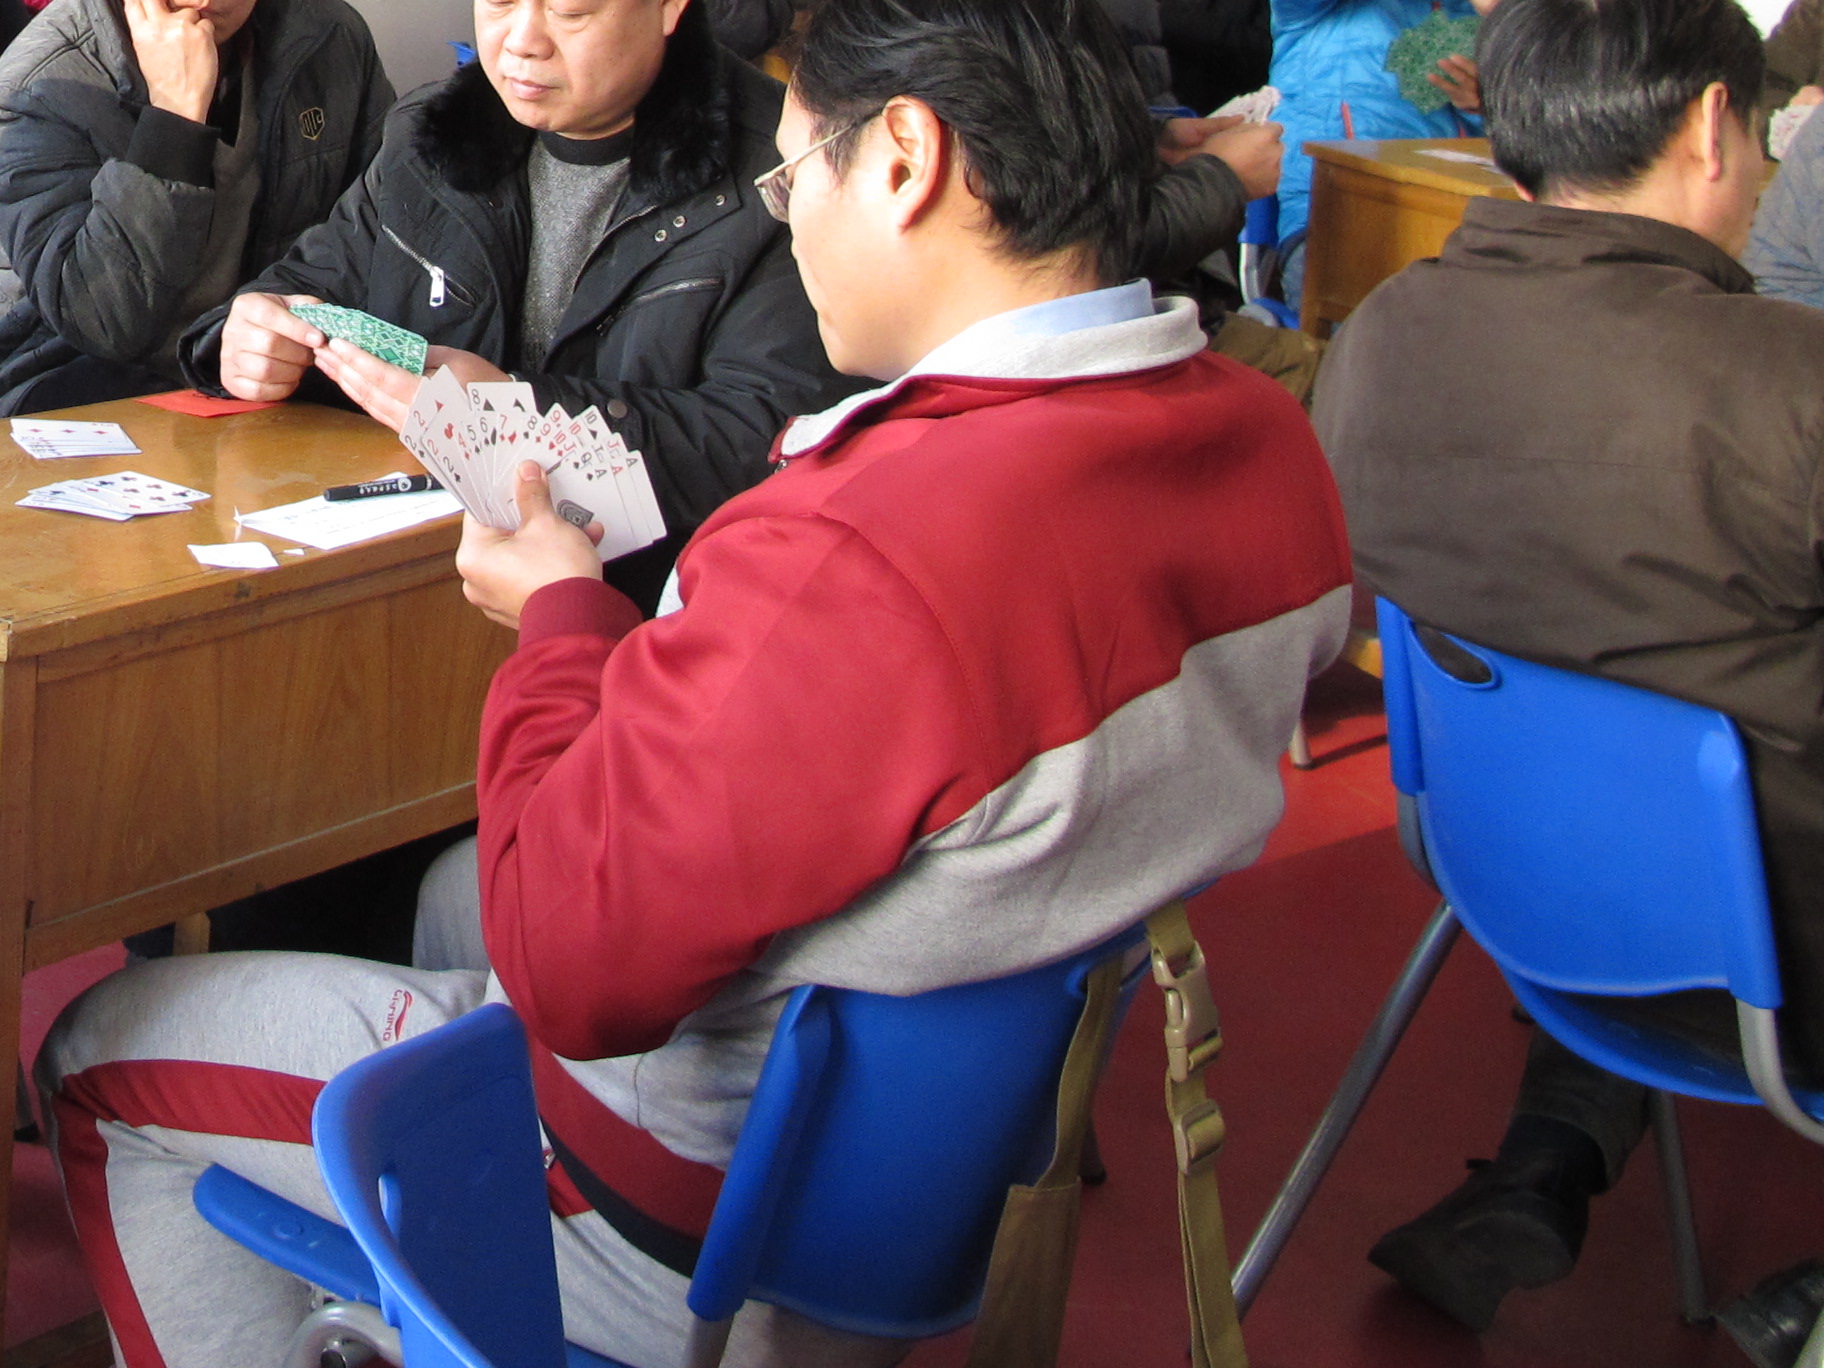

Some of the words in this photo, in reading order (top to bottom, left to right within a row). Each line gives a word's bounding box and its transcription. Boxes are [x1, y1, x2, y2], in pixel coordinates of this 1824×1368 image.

[472, 389, 480, 404] 8
[414, 411, 424, 426] 2
[500, 415, 507, 429] 7
[528, 416, 538, 430] 8
[550, 410, 561, 423] 9
[584, 411, 597, 424] 10
[480, 417, 487, 432] 6
[540, 424, 551, 436] 9
[569, 422, 581, 435] 10
[467, 425, 476, 440] 5
[554, 430, 566, 444] 10
[405, 435, 416, 450] 2
[458, 432, 466, 448] 4
[564, 442, 577, 451] J
[608, 441, 620, 449] J
[427, 440, 438, 455] 2
[443, 457, 454, 472] 2
[626, 457, 638, 467] A
[595, 469, 607, 479] A
[610, 466, 623, 476] A
